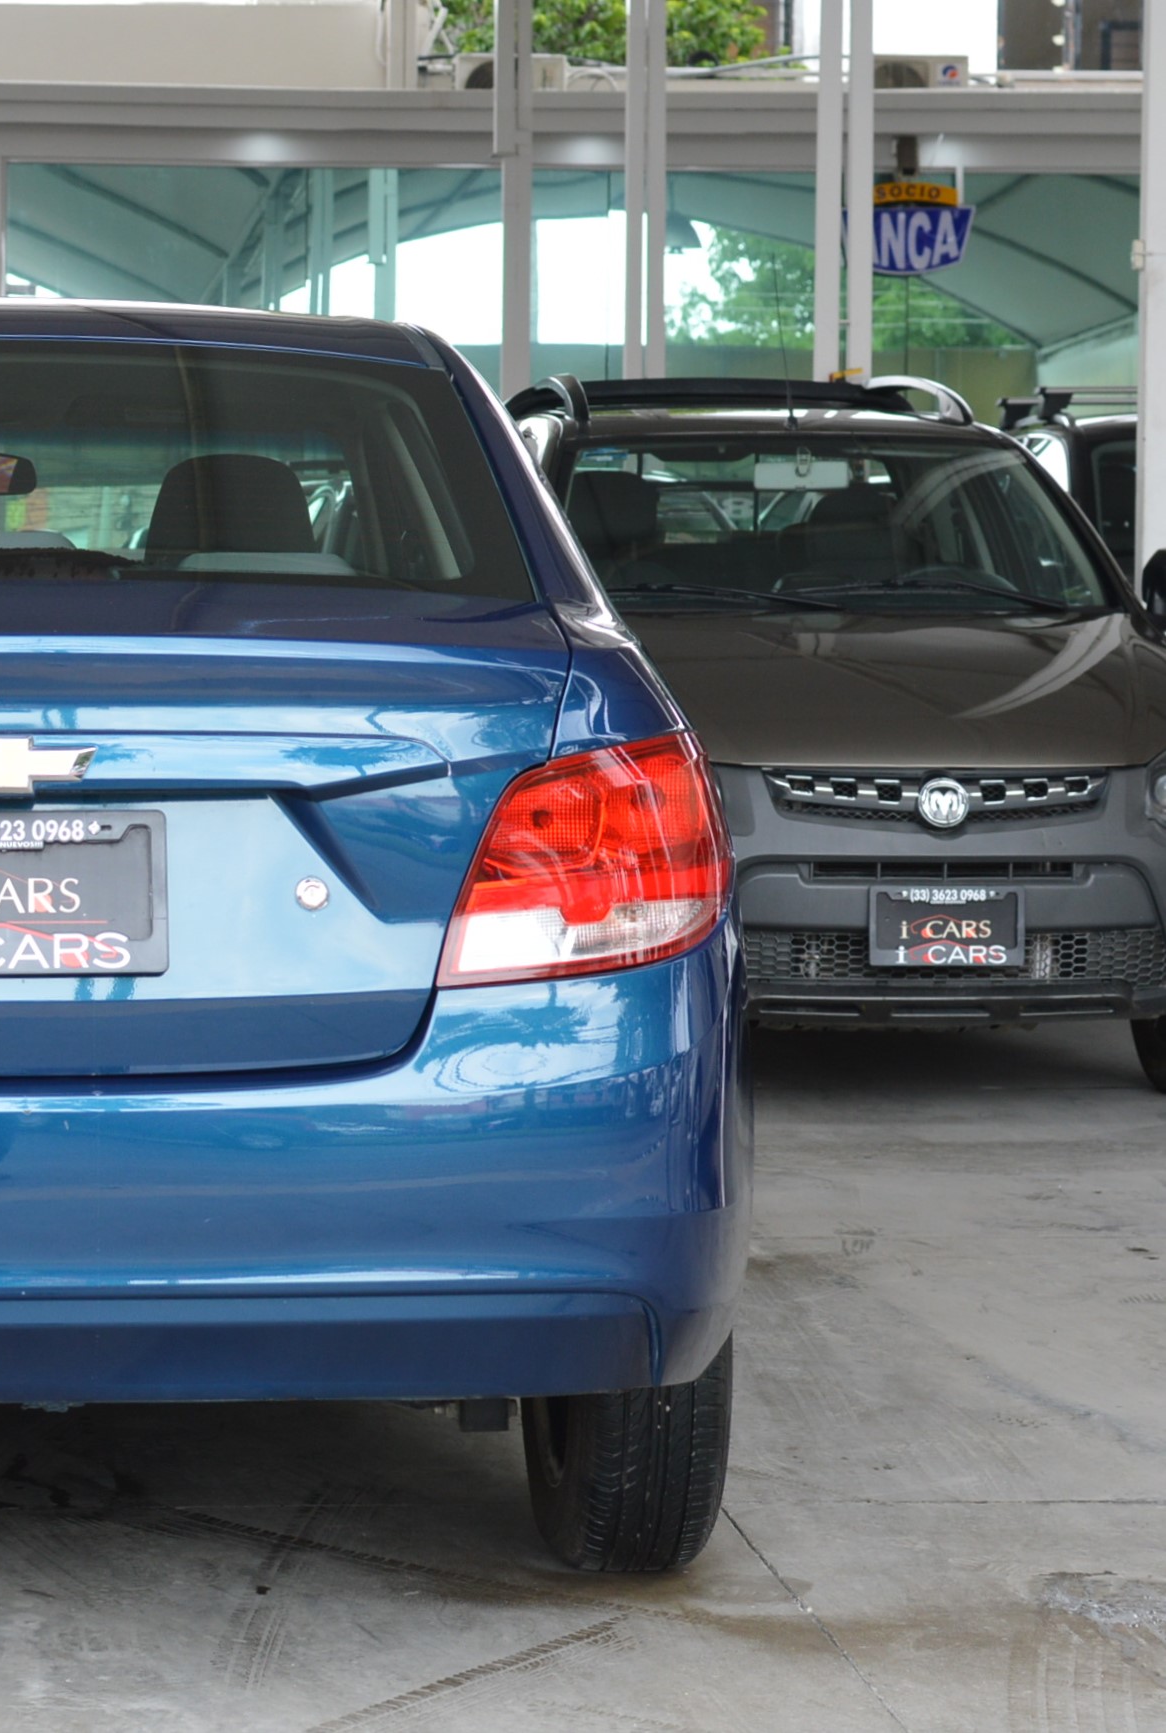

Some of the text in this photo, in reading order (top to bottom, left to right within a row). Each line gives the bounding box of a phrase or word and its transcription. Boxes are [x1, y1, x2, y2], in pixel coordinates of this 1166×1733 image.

[875, 184, 941, 198] SOCIO
[873, 209, 960, 271] NCA
[32, 819, 85, 842] 0968
[910, 888, 987, 902] (33) 3623 0968
[899, 920, 992, 939] i CARS
[895, 945, 1007, 964] i CARS
